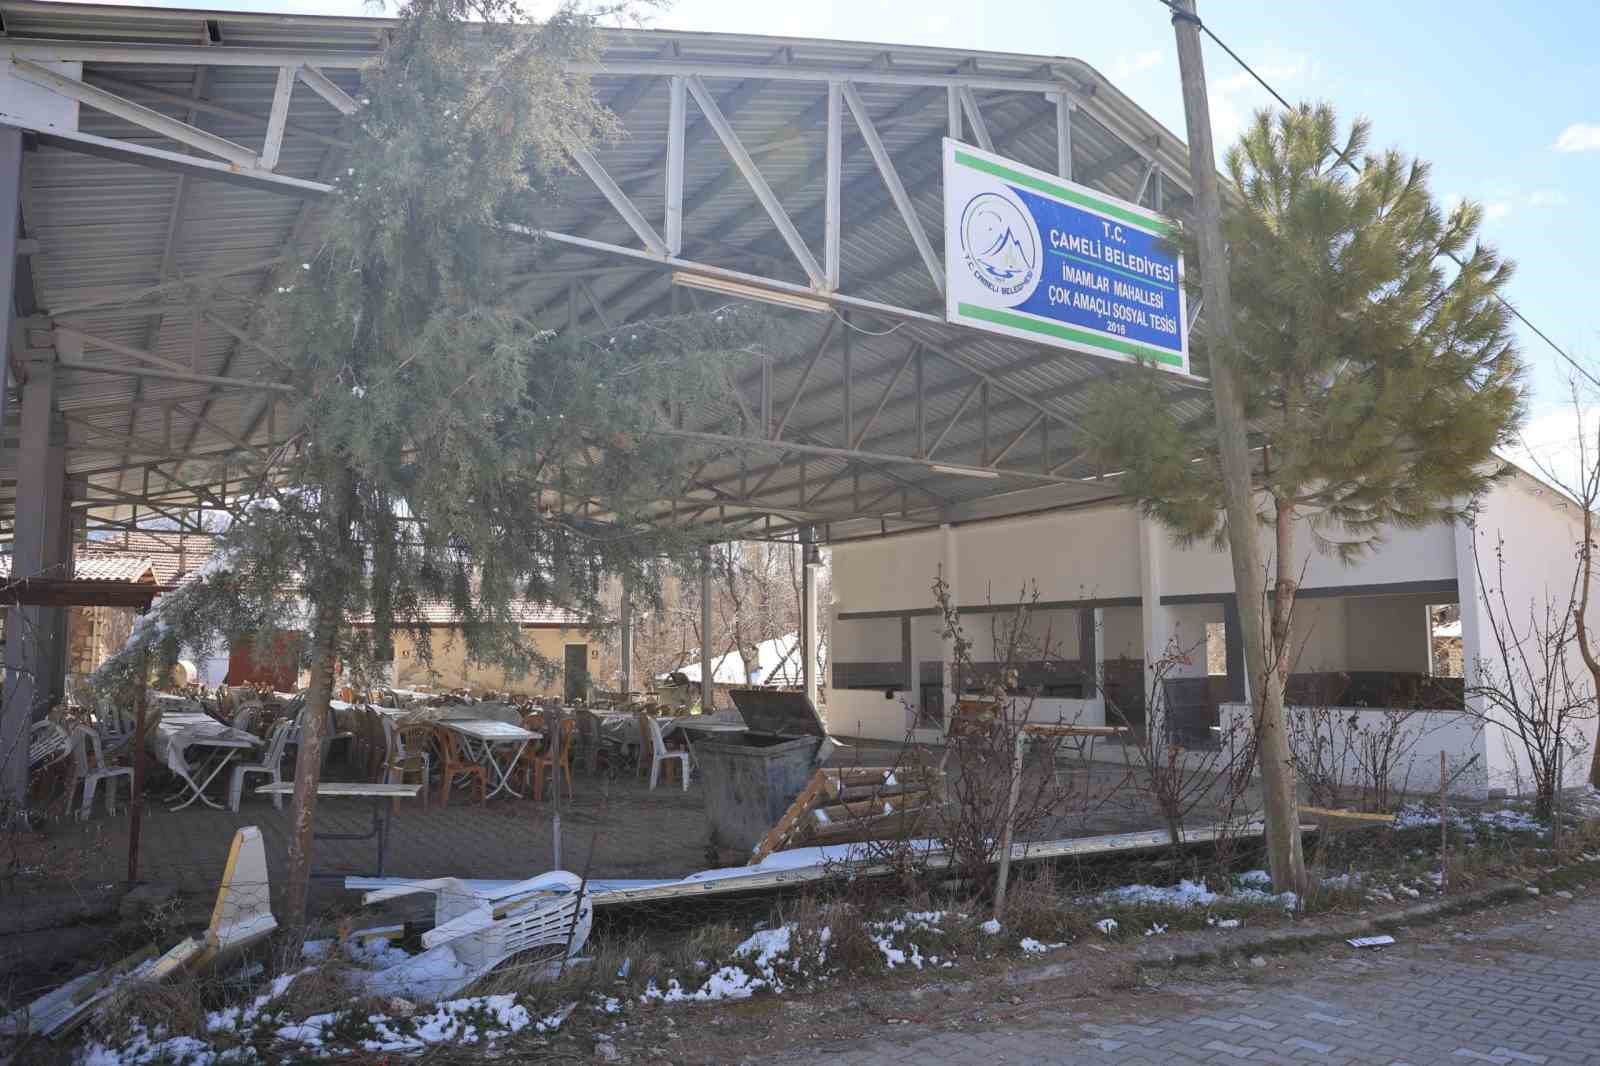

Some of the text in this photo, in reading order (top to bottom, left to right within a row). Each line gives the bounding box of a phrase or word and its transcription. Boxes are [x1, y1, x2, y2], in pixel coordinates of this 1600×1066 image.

[1050, 229, 1175, 283] ÇAMELİ BELEDİYESİ
[1102, 221, 1127, 244] T.C.
[1048, 285, 1177, 335] ÇOK AMAÇLI SOSYAL TESİSİ
[1062, 261, 1164, 310] İMAMLAR MAHALLESİ
